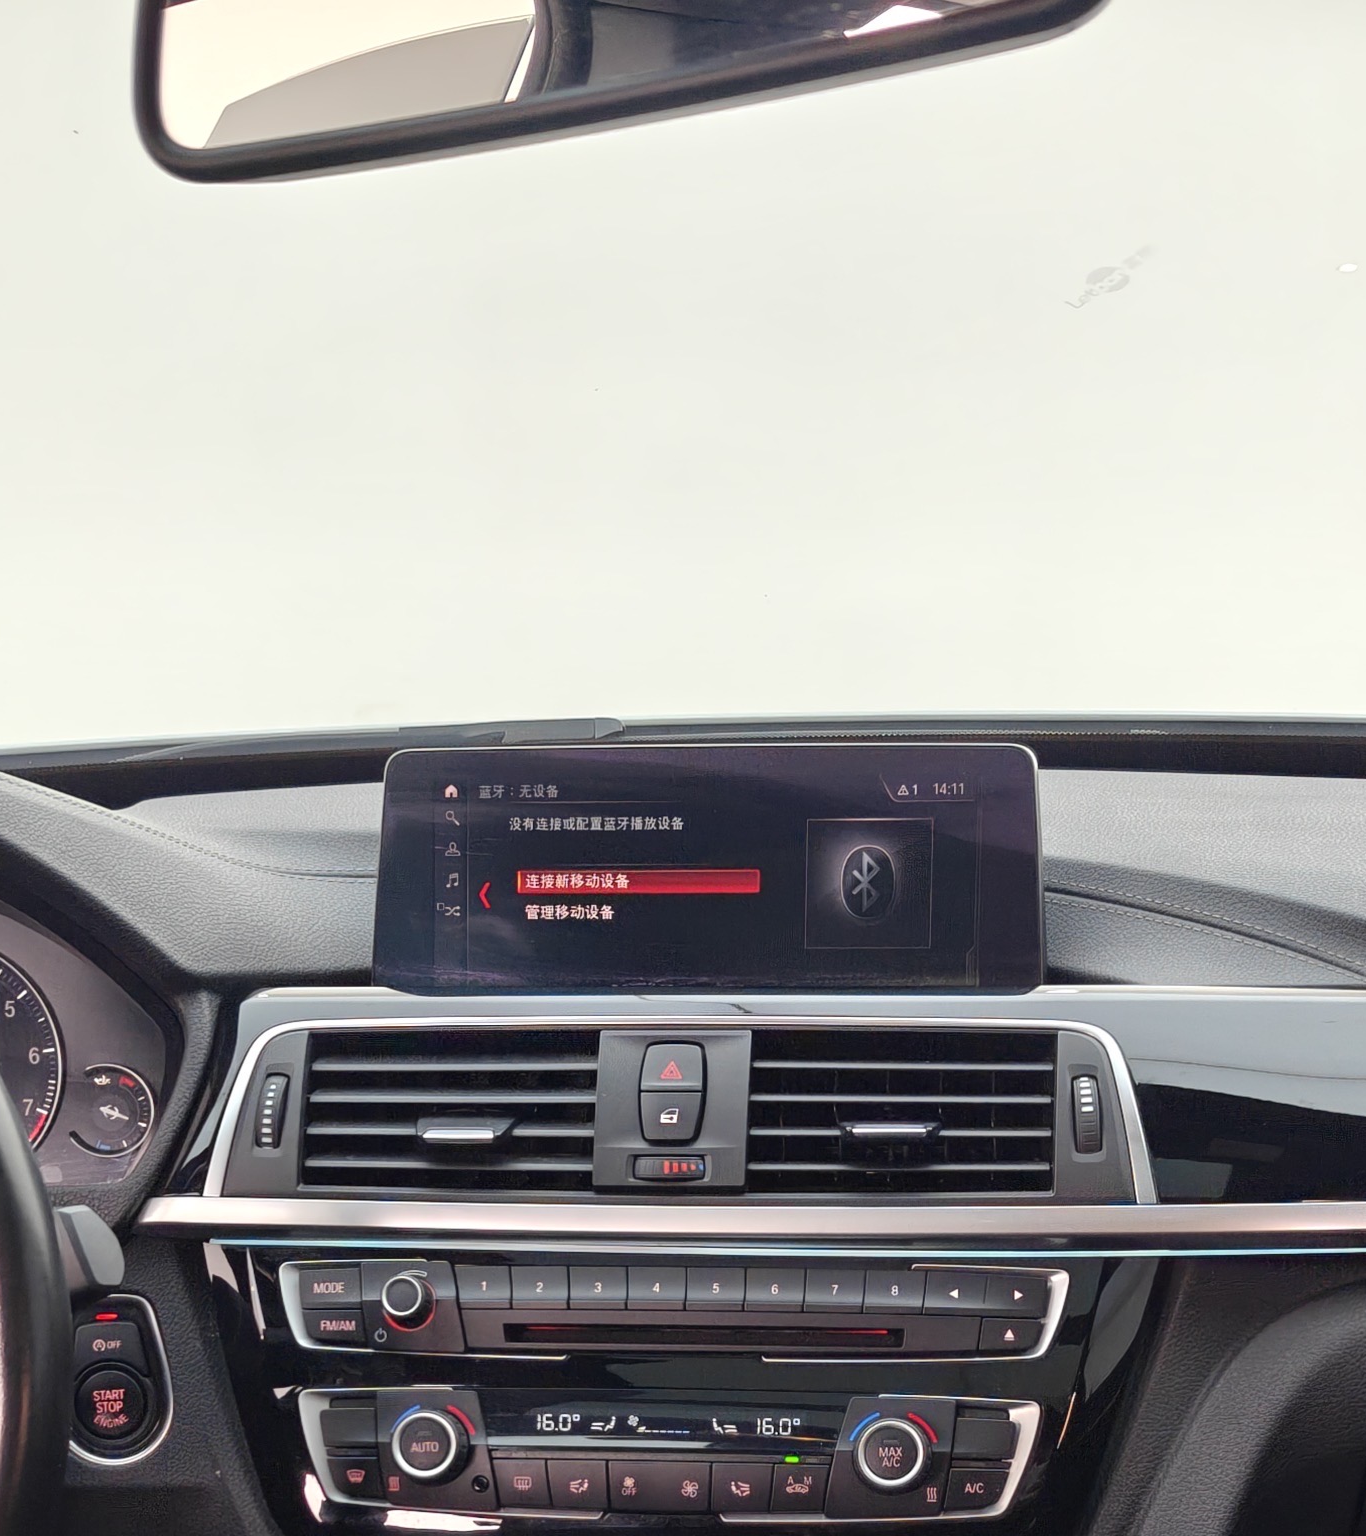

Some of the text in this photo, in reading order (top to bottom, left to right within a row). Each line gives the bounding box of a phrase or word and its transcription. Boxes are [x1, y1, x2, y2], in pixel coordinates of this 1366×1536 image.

[933, 783, 964, 795] 14:11
[509, 816, 685, 831] 没有连接或配置蓝牙播放设备
[525, 873, 630, 889] 连接新移动设备
[525, 904, 615, 920] 管理移动设备
[4, 1000, 16, 1017] 5
[28, 1047, 40, 1064] 6
[22, 1098, 34, 1115] 7
[313, 1282, 345, 1294] MODE
[481, 1281, 487, 1292] 1
[535, 1282, 543, 1293] 2
[594, 1282, 602, 1294] 3
[652, 1283, 660, 1294] 4
[712, 1283, 720, 1294] 5
[771, 1284, 779, 1295] 6
[831, 1284, 839, 1296] 7
[891, 1285, 899, 1297] 8
[320, 1320, 356, 1332] FM/AM
[107, 1340, 122, 1349] OFF
[93, 1389, 125, 1400] START
[96, 1402, 123, 1413] STOP
[94, 1414, 129, 1428] ENGINE
[410, 1441, 439, 1453] AUTO
[878, 1447, 903, 1458] MAX
[882, 1457, 901, 1468] A/C
[622, 1487, 638, 1496] OFF
[965, 1482, 984, 1494] A/C
